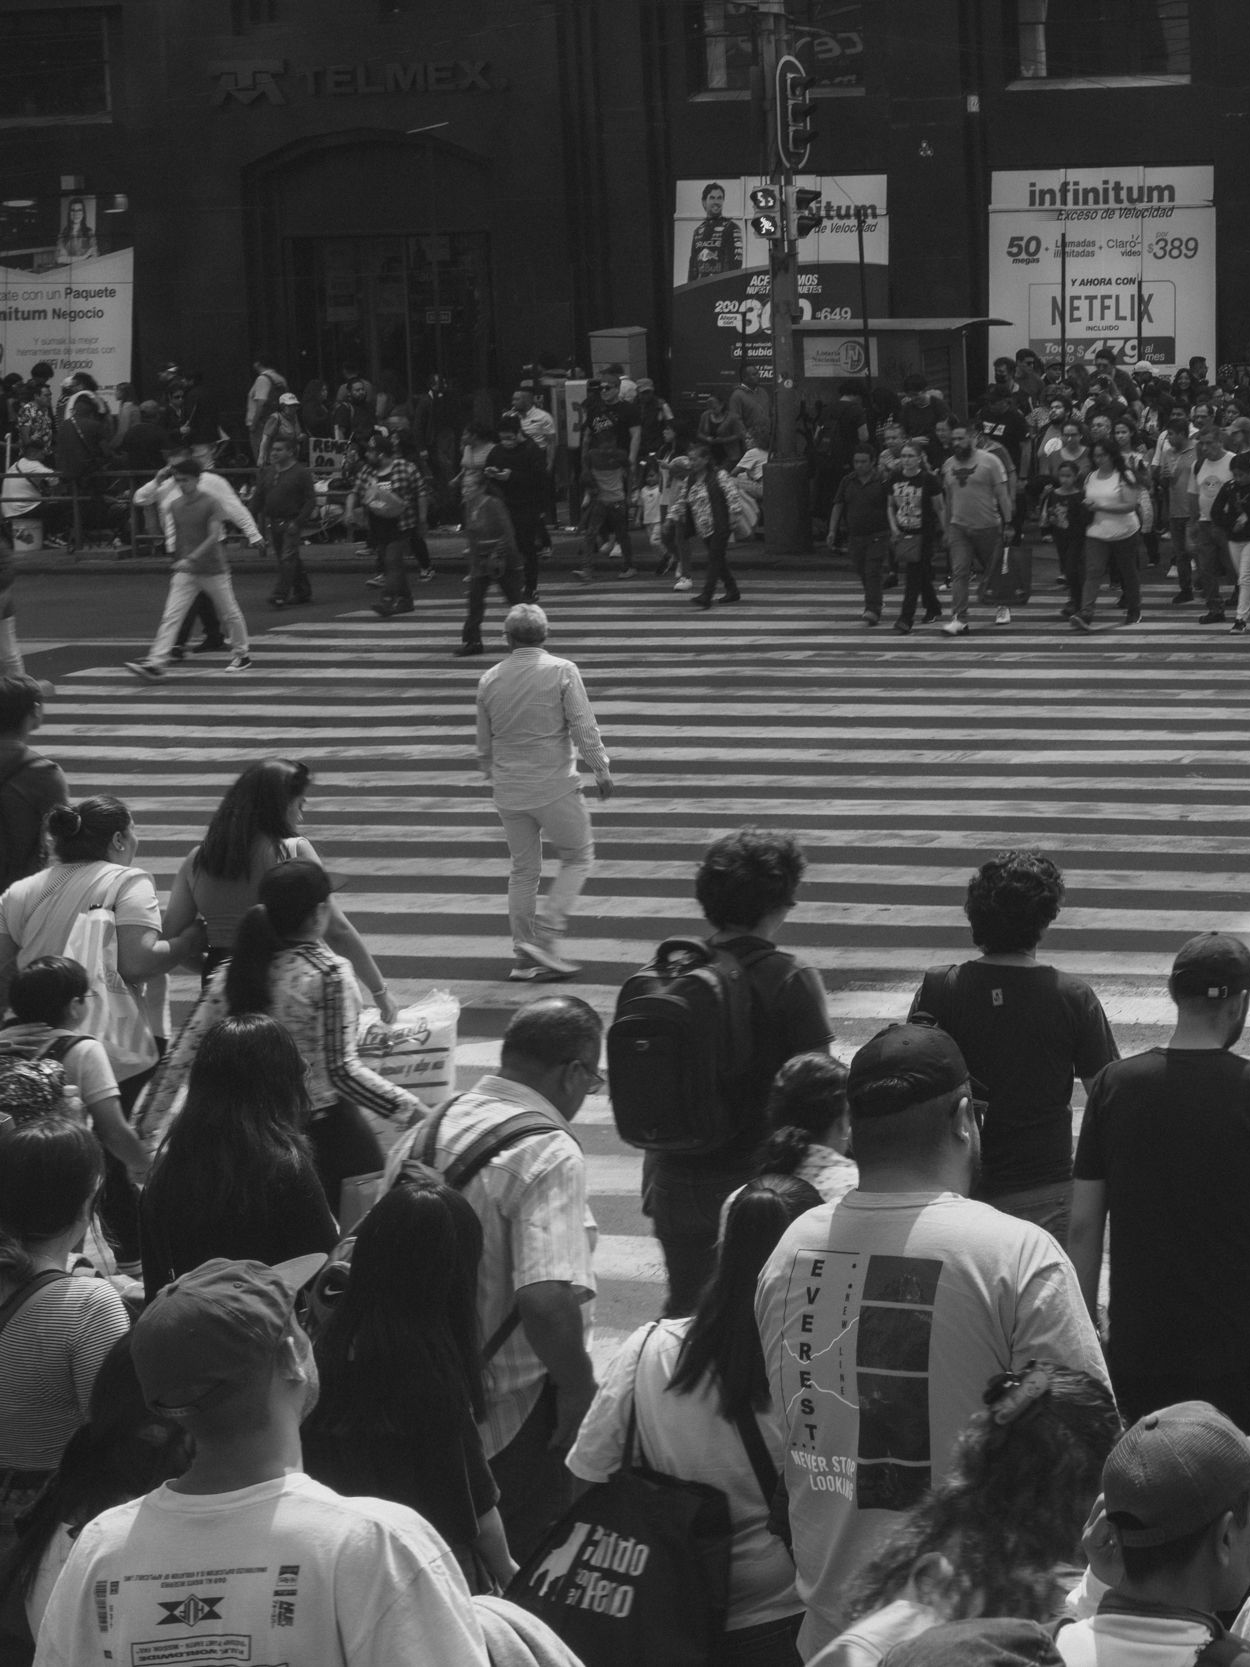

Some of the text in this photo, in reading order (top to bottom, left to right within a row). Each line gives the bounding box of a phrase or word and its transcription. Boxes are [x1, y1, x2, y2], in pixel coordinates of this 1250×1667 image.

[298, 60, 492, 95] TELMEX
[1028, 180, 1176, 207] infinitum
[1056, 206, 1175, 221] Exceso de Velocidad
[1006, 235, 1042, 257] 50
[1106, 238, 1137, 249] Claro
[1012, 256, 1040, 265] megas
[1071, 276, 1136, 286] Y AHORA CON
[46, 287, 61, 300] un
[64, 286, 117, 301] Paquete
[714, 300, 739, 313] 200
[1051, 293, 1155, 326] NETFLIX
[52, 307, 104, 322] Negocio
[1085, 324, 1120, 332] INCLUIDO
[800, 1259, 825, 1441] EVEREST
[790, 1450, 856, 1474] NEVER STOP
[809, 1474, 855, 1502] LOOKING
